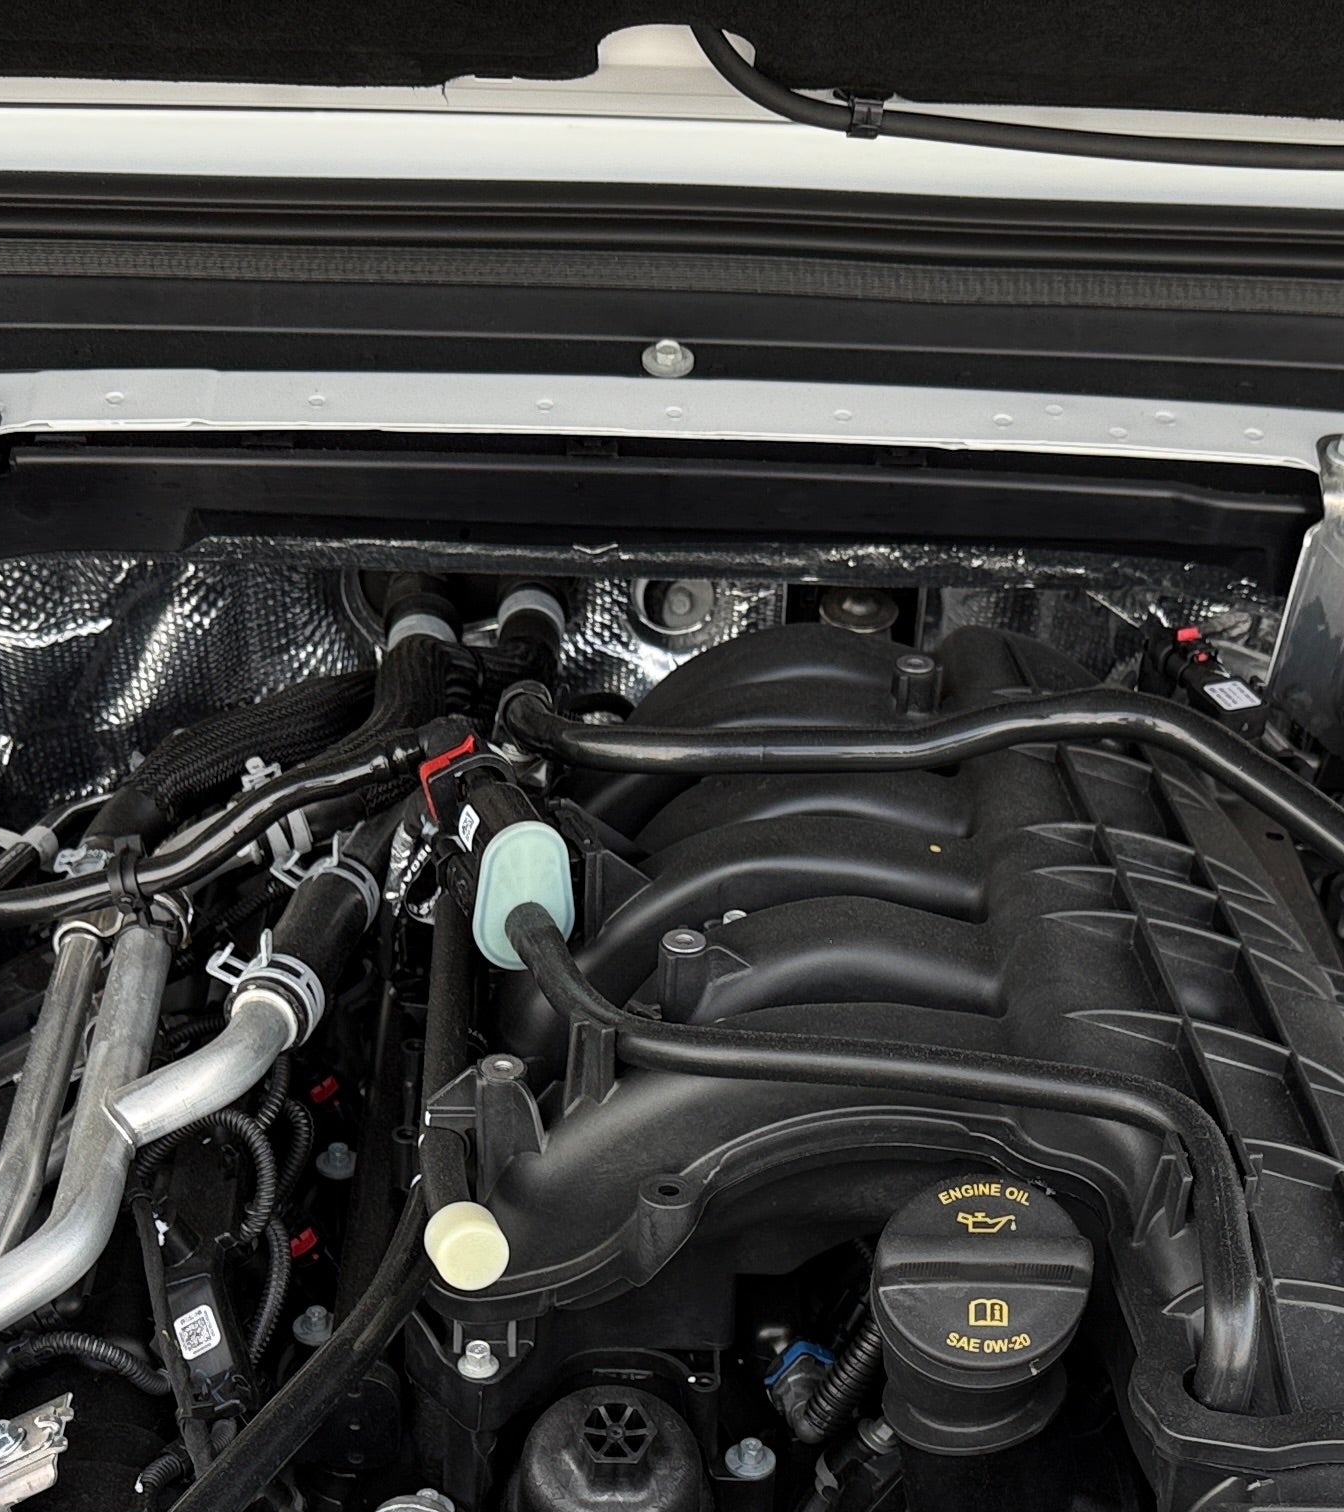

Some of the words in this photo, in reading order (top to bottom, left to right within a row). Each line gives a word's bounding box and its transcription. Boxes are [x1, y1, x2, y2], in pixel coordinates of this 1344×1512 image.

[938, 1183, 1002, 1205] ENGINE
[1005, 1186, 1030, 1206] OIL
[946, 1332, 981, 1353] SAE
[983, 1333, 1031, 1353] 0W-20
